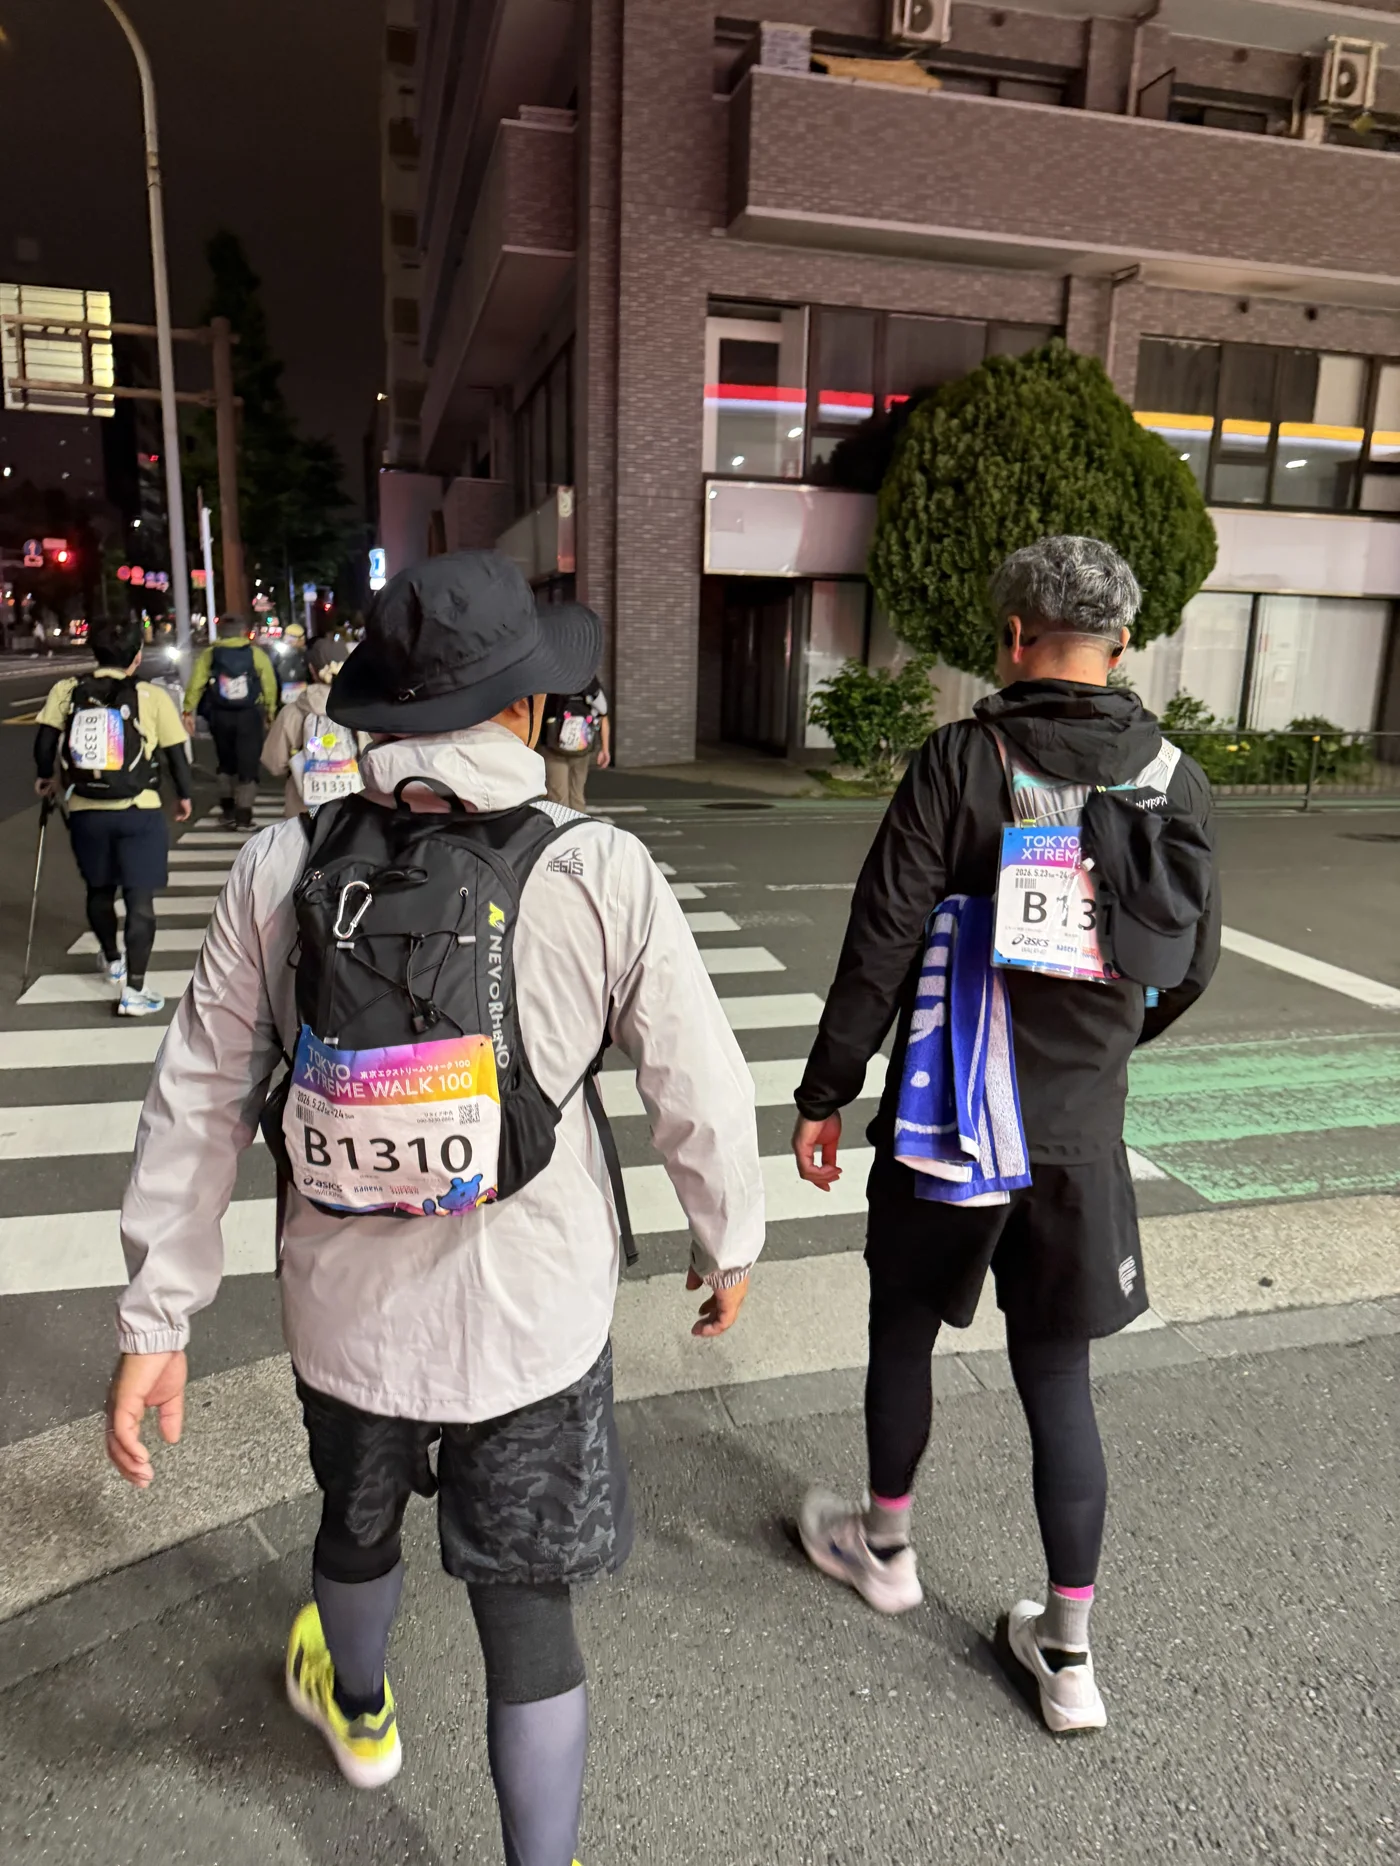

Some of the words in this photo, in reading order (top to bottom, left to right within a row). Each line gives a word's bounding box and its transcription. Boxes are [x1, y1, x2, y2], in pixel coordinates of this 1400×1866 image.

[1023, 835, 1080, 849] TOKYO
[1021, 848, 1077, 862] XTREM
[546, 860, 584, 876] AEGIS
[307, 1045, 351, 1080] TOKYO
[454, 1059, 471, 1069] 100
[303, 1063, 366, 1098] XTREME
[369, 1076, 434, 1098] WALK
[438, 1071, 473, 1093] 100
[303, 1126, 473, 1175] B1310
[315, 1179, 343, 1193] asics
